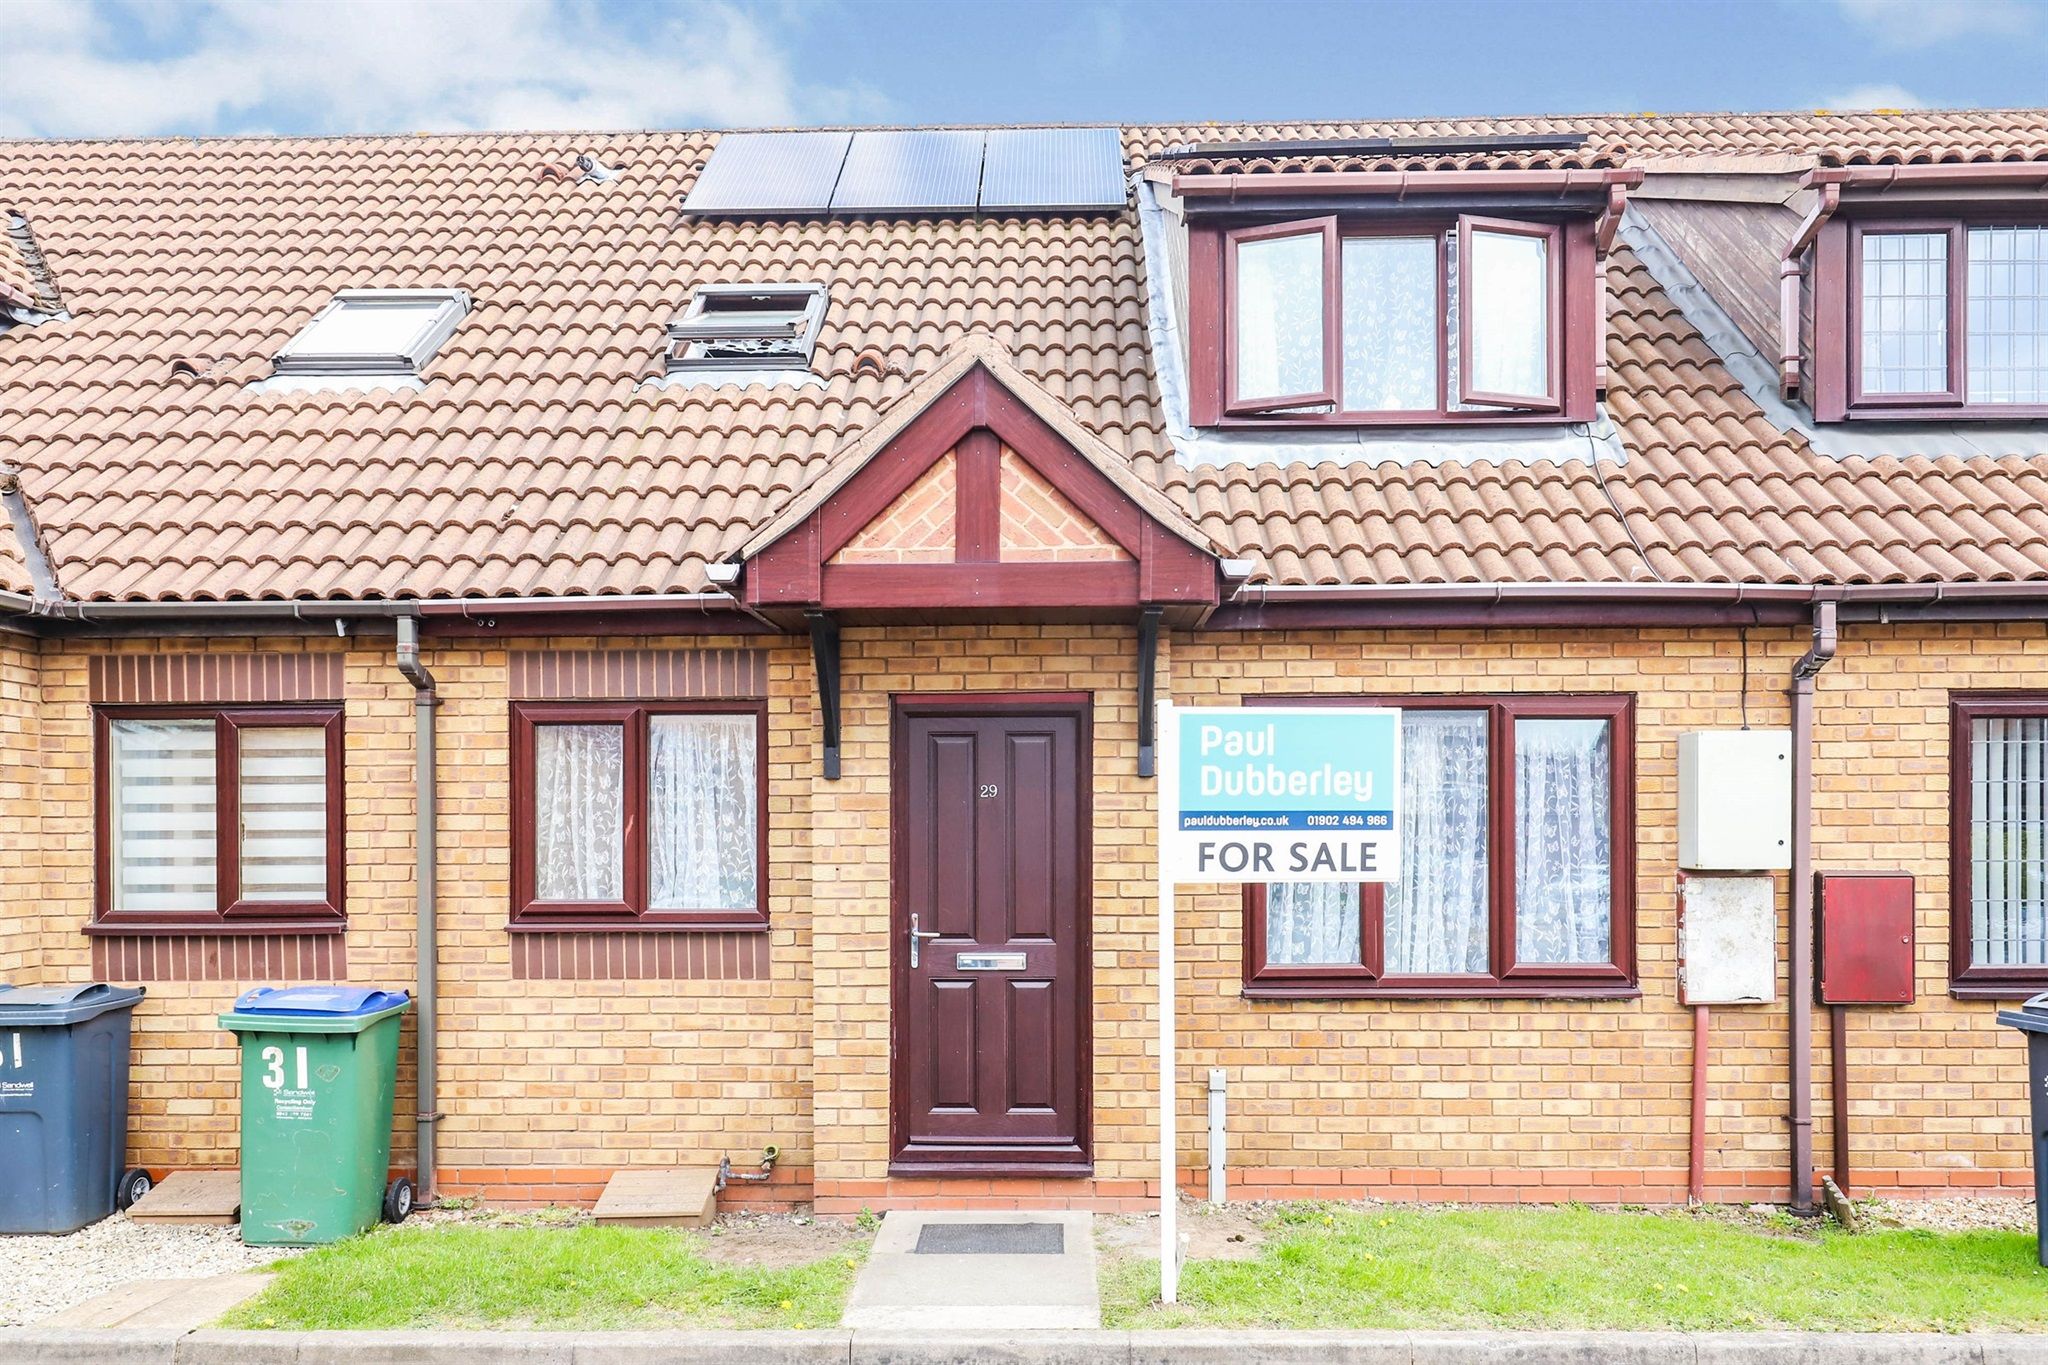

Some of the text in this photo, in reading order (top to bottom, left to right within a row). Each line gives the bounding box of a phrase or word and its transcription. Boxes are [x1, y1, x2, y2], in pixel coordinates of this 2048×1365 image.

[1200, 723, 1275, 757] Paul
[980, 784, 998, 798] 29
[1200, 763, 1374, 802] Dubberley
[1184, 815, 1290, 828] pauldubberley.co.uk
[1307, 815, 1388, 826] 01902 494 966
[1198, 842, 1377, 873] FOR SALE
[262, 1046, 308, 1089] 31
